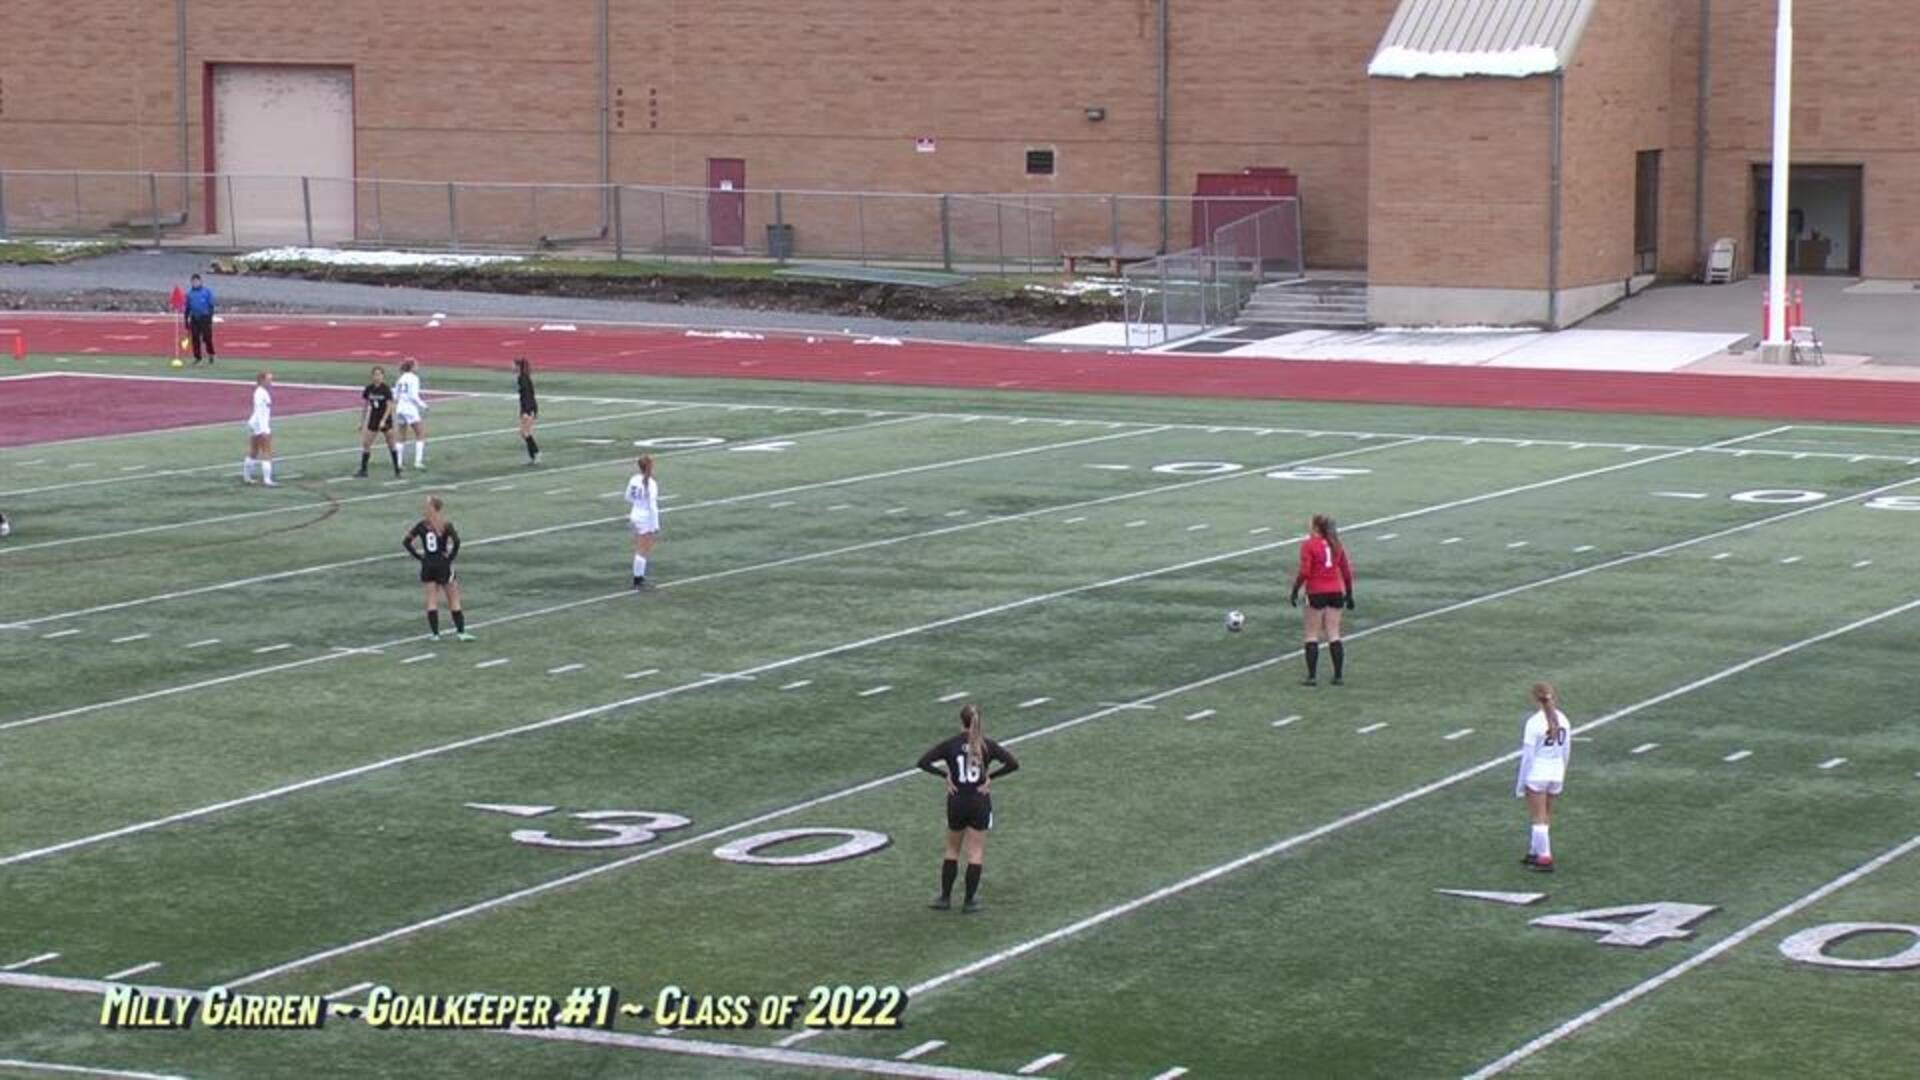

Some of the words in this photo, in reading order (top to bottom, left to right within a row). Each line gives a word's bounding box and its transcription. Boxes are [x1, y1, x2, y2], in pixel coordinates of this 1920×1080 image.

[426, 530, 438, 552] 8
[1323, 546, 1333, 568] 1
[1543, 726, 1567, 746] 20
